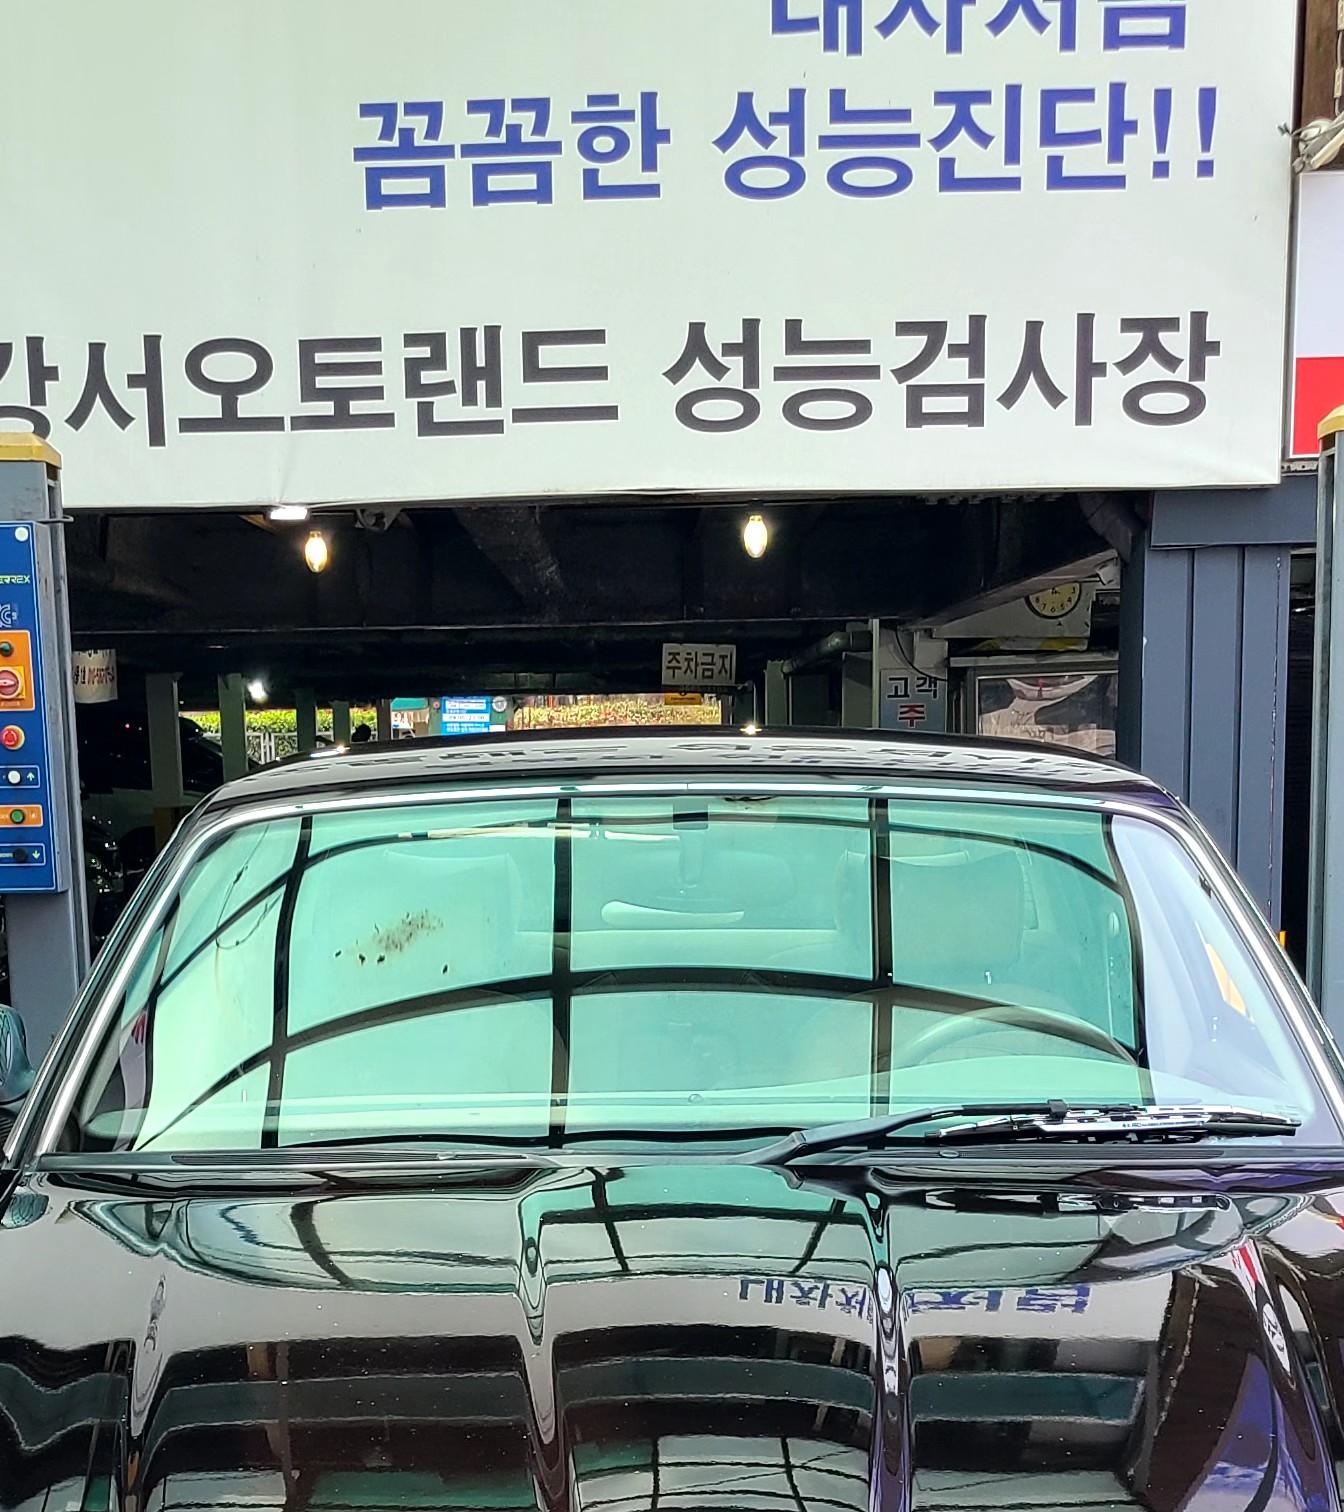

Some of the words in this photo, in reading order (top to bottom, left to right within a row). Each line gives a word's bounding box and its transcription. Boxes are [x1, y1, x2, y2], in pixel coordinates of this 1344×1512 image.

[353, 92, 671, 210] 꼼꼼한
[712, 82, 1217, 199] 성능진단!!
[662, 311, 1220, 432] 성능검사장
[665, 651, 733, 680] 주차금지
[887, 676, 938, 699] 고객
[898, 704, 926, 727] 주
